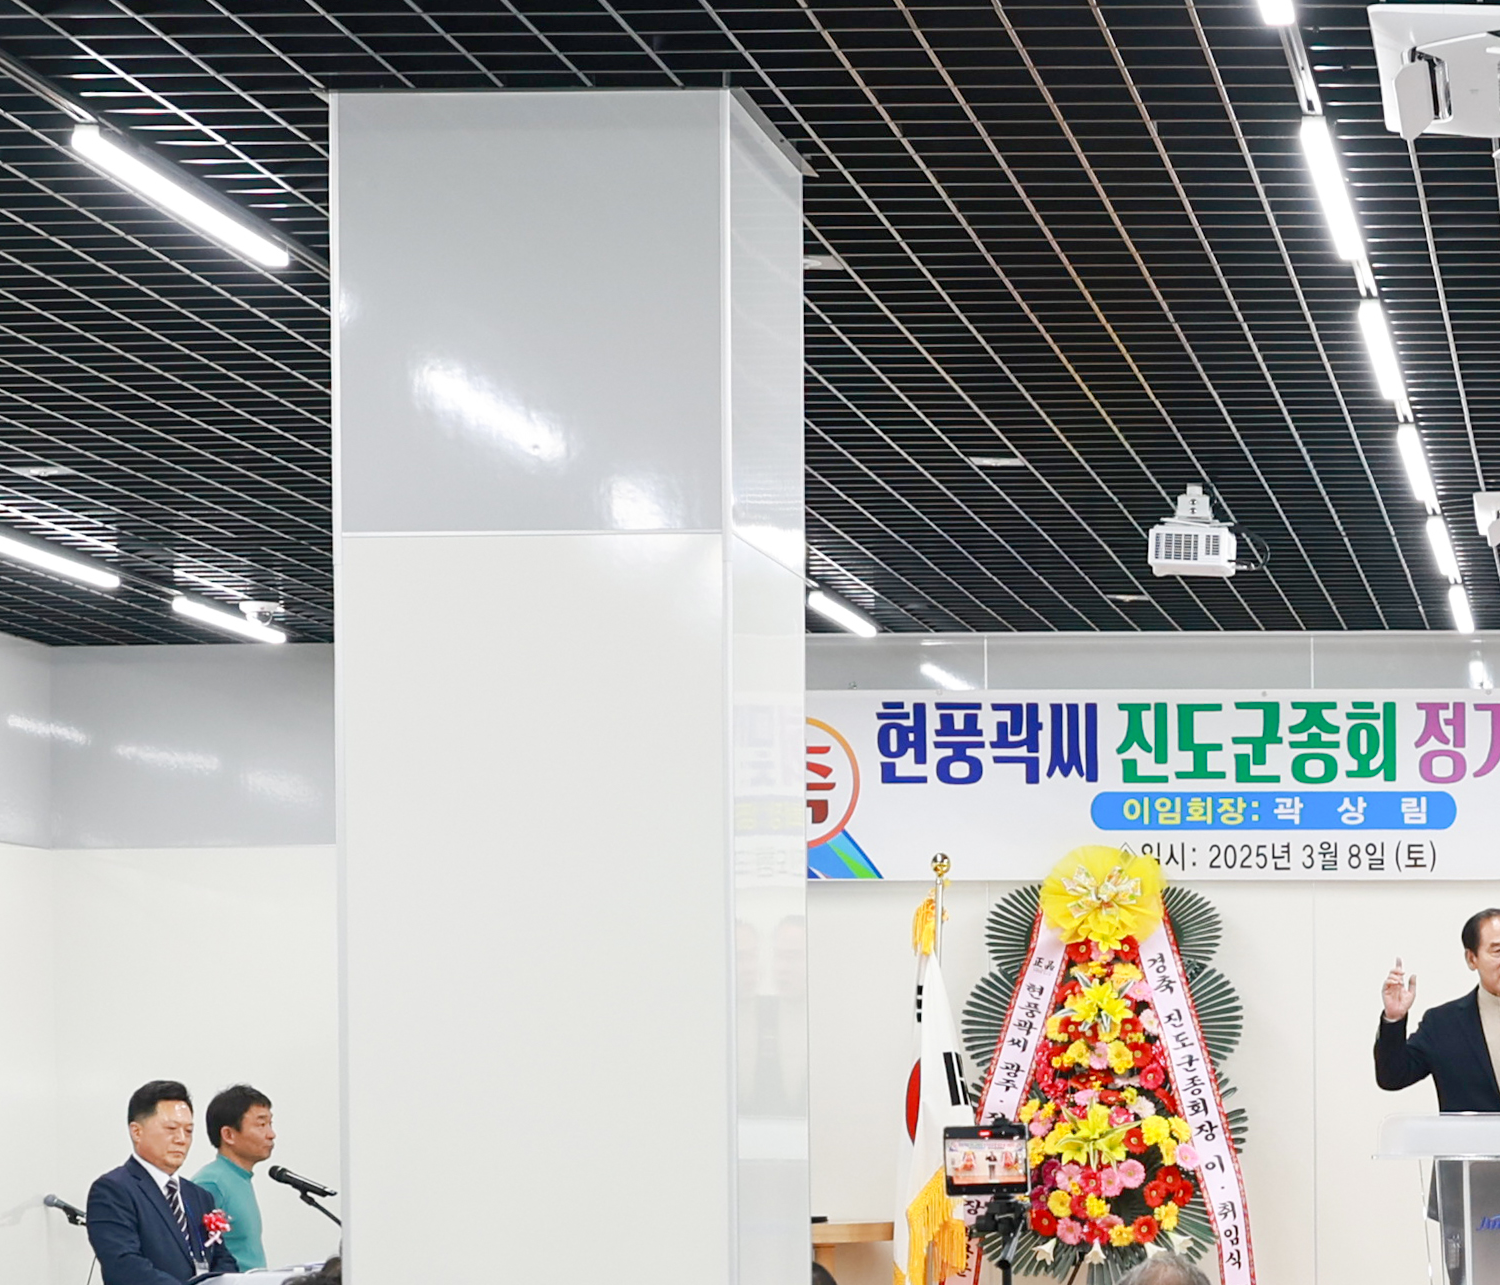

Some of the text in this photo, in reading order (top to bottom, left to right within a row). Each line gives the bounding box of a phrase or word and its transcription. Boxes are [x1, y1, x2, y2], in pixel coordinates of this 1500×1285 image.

[875, 701, 1099, 785] 현풍곽씨
[1115, 701, 1397, 785] 진도군종회
[1123, 797, 1259, 825] 이임회장:
[1209, 843, 1291, 871] 2025년
[1302, 841, 1338, 871] 3월
[1348, 842, 1384, 871] 8일
[1395, 840, 1436, 872] (토)
[1007, 983, 1045, 1053] 현풍곽씨
[1147, 952, 1177, 994] 경축
[1164, 1008, 1219, 1142] 진도군종회장
